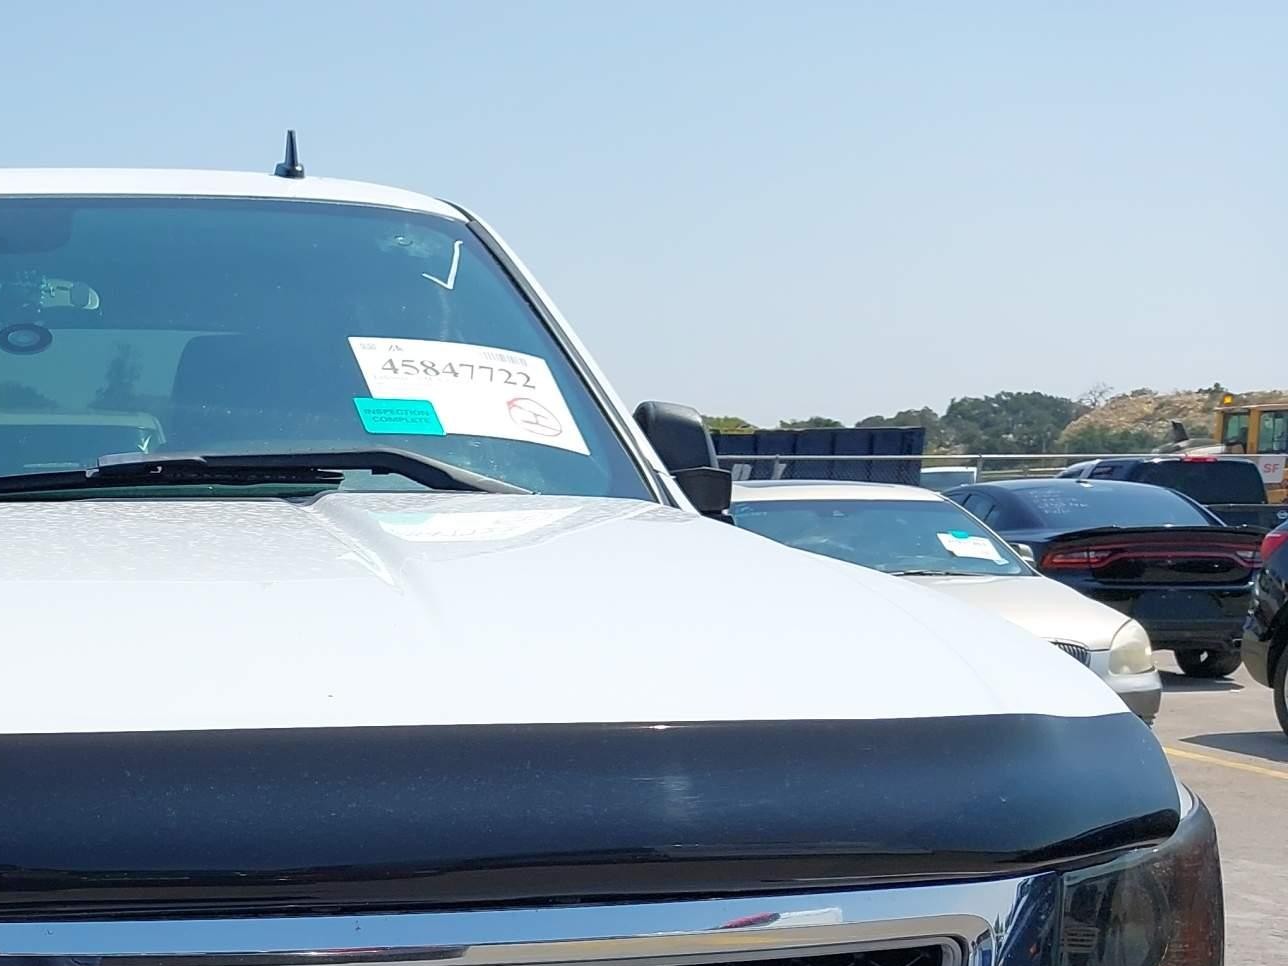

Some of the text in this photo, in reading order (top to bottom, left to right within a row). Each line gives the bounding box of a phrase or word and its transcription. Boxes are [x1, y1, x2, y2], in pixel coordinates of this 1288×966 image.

[381, 358, 536, 389] 45847722
[362, 408, 430, 417] INSPECTION
[371, 416, 430, 424] COMPLETE
[1263, 463, 1280, 473] SF
